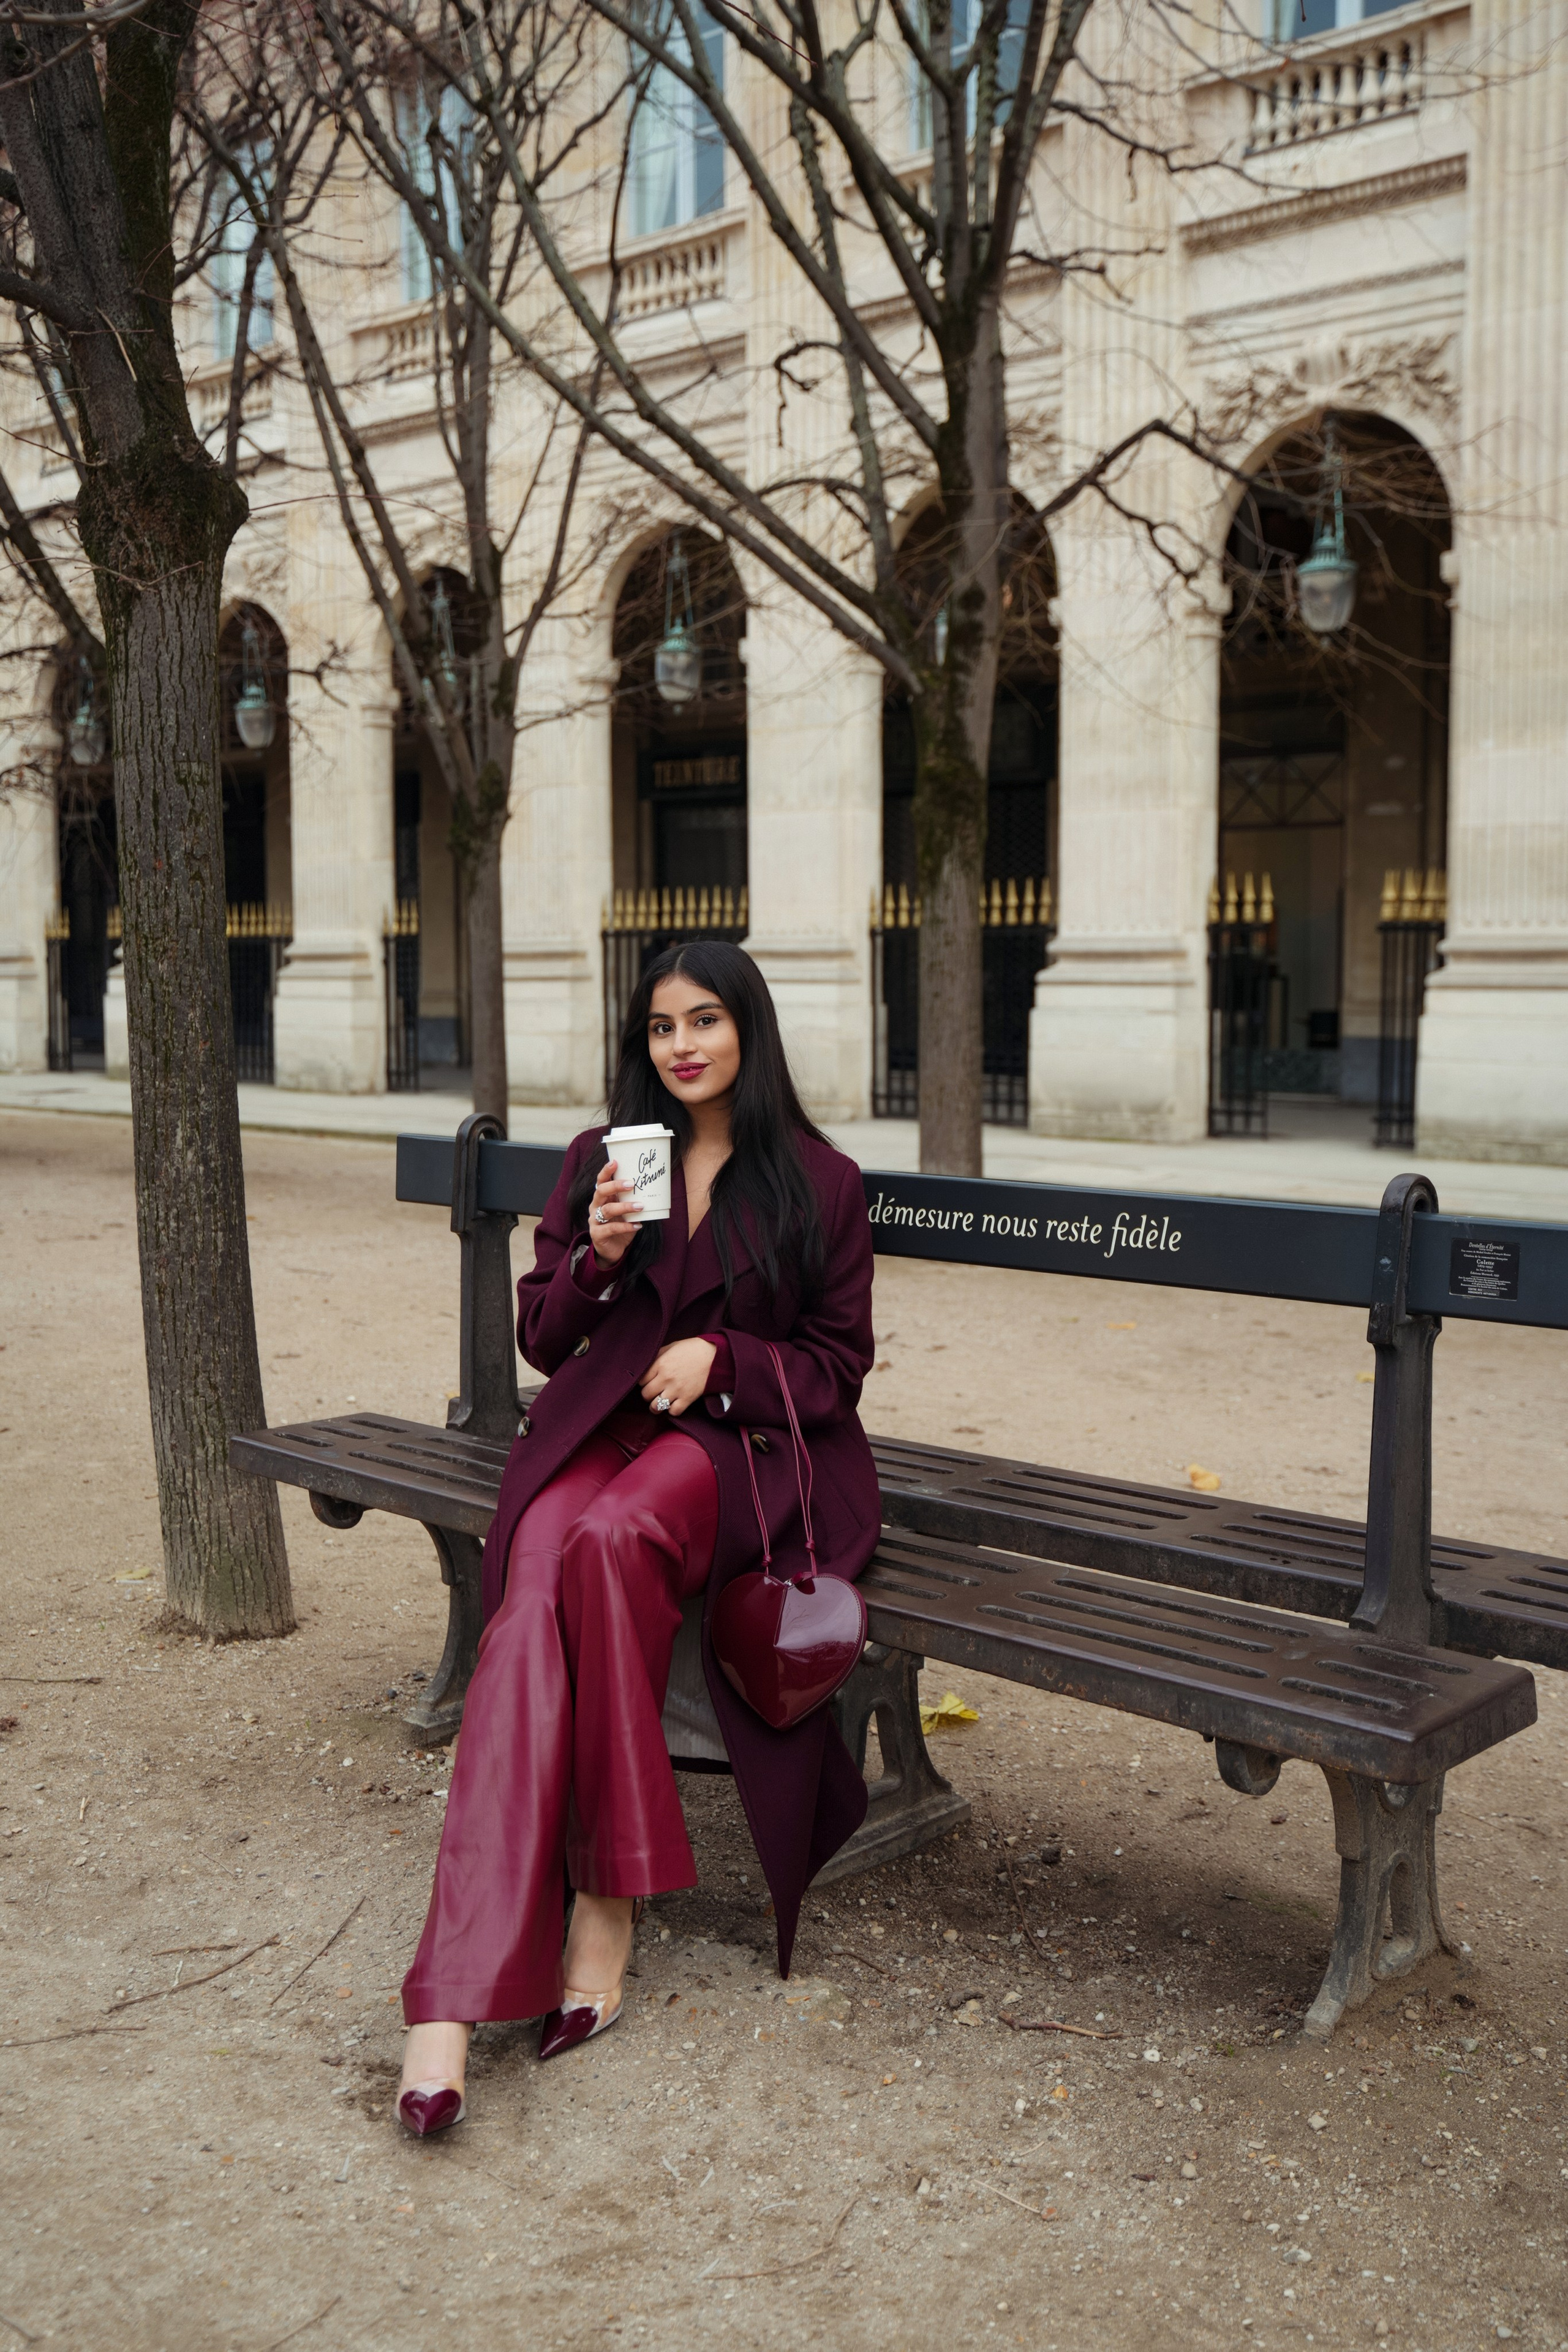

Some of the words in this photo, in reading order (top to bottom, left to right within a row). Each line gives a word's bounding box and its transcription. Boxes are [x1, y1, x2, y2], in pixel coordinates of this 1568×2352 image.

[638, 1148, 657, 1174] Café
[633, 1162, 666, 1194] Kitsuné
[868, 1192, 974, 1232] démesure
[982, 1213, 1038, 1238] nous
[1046, 1215, 1102, 1244] reste
[1103, 1212, 1182, 1258] fidèle
